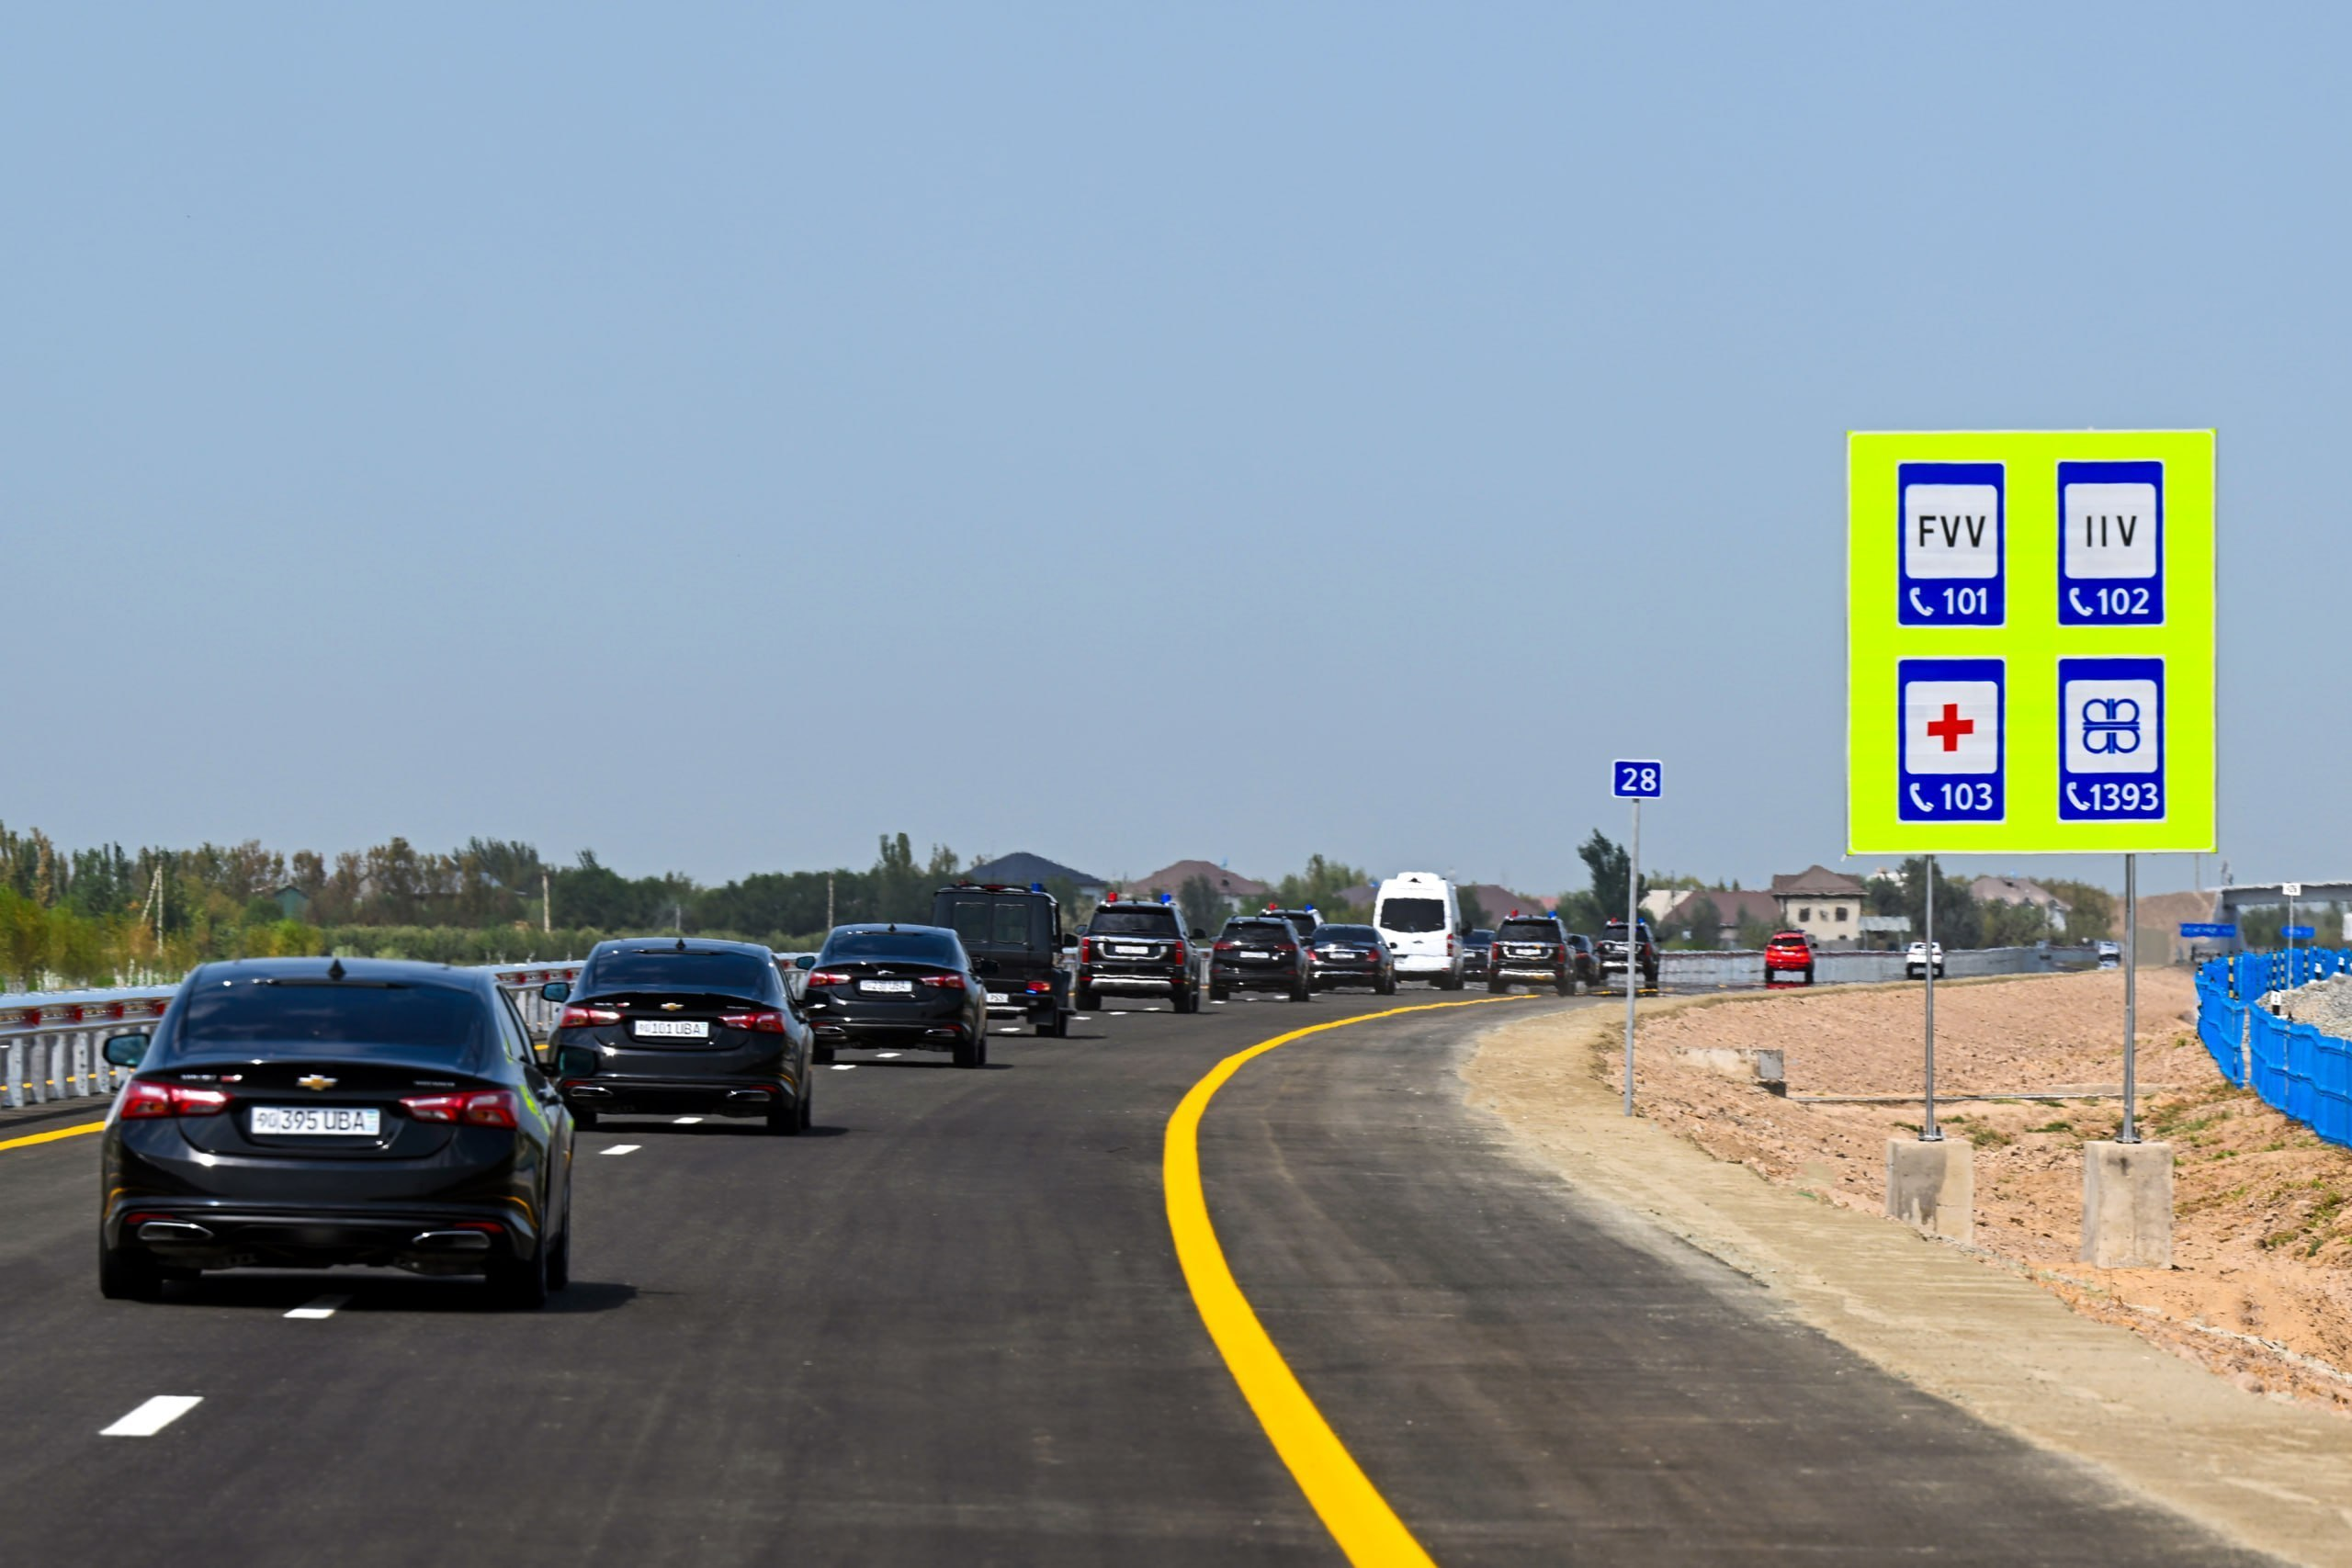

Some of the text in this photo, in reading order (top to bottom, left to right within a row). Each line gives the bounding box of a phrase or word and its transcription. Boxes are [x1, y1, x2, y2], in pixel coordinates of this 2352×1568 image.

[1918, 514, 1986, 547] FVV
[2086, 514, 2137, 547] IIV
[1943, 587, 1987, 615] 101
[2097, 588, 2150, 615] 102
[1622, 767, 1657, 792] 28
[1940, 783, 1993, 810] 103
[2090, 783, 2159, 810] 1393
[675, 1023, 700, 1035] UBA
[281, 1111, 317, 1130] 395
[323, 1111, 365, 1131] UBA
